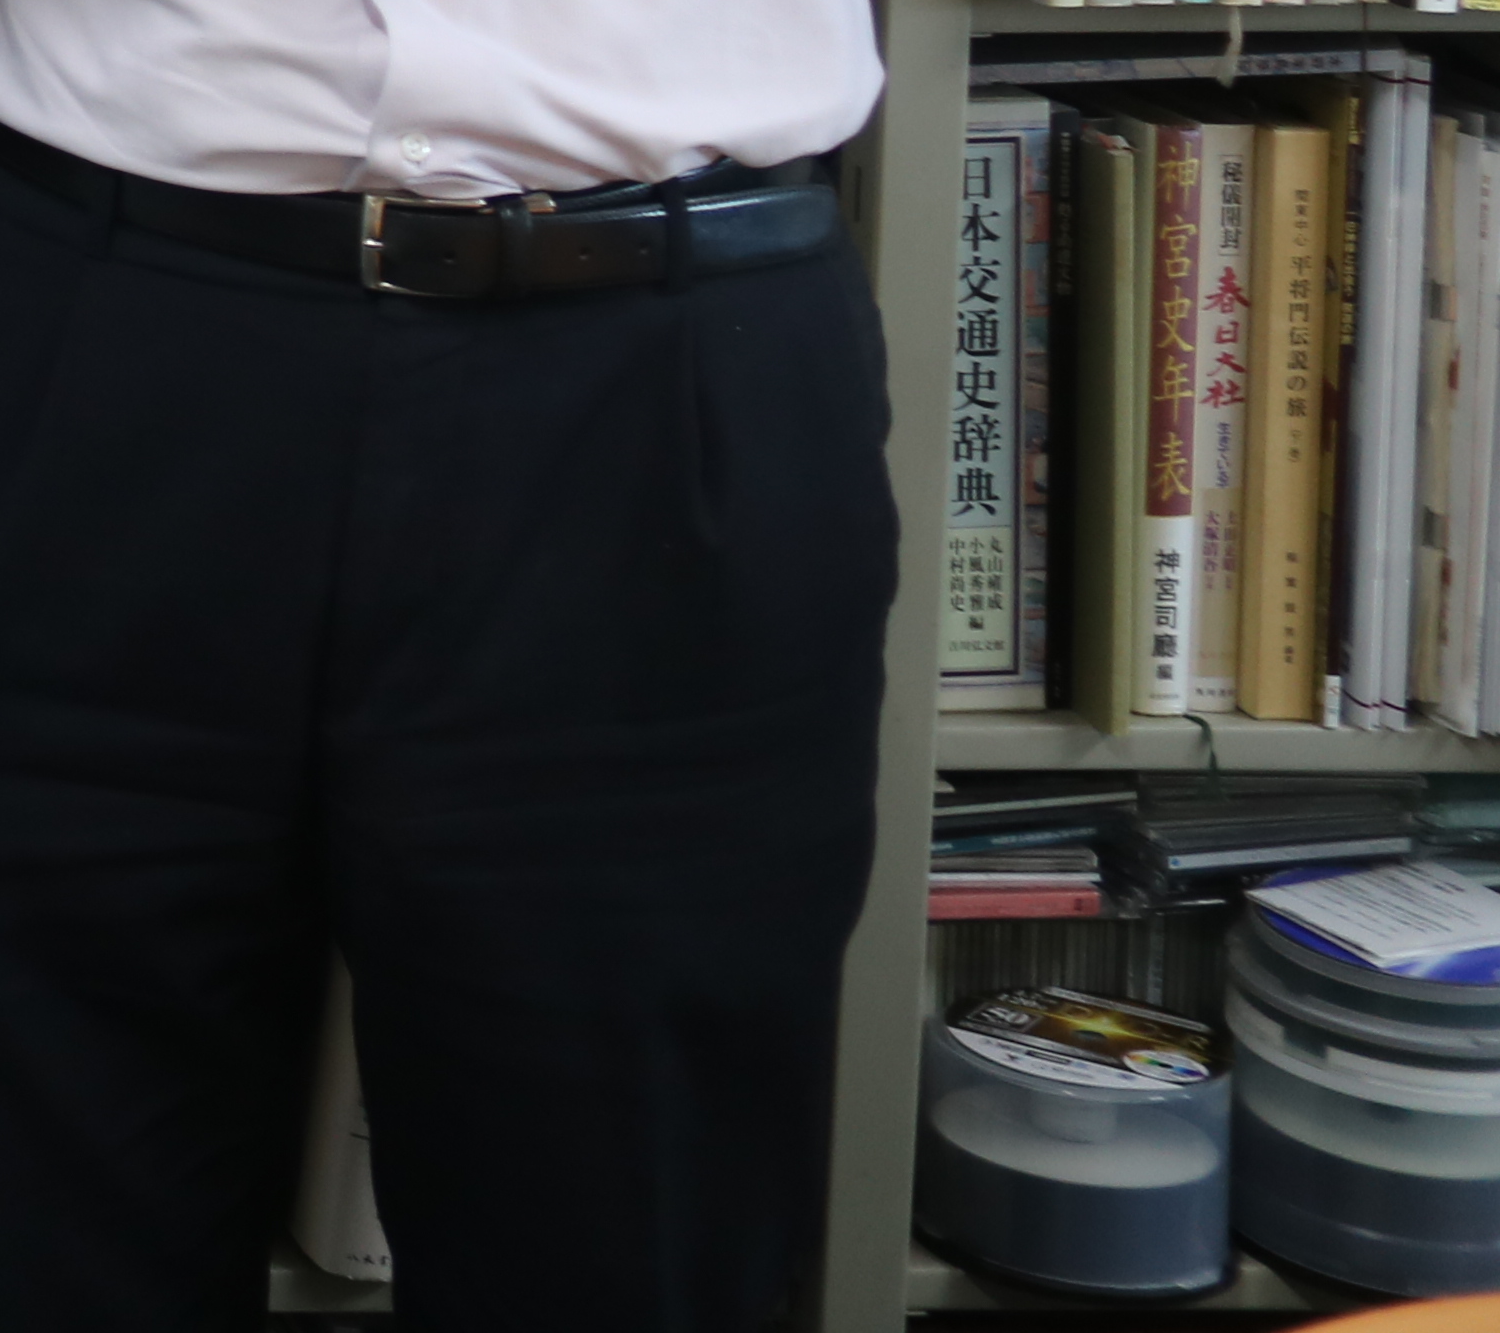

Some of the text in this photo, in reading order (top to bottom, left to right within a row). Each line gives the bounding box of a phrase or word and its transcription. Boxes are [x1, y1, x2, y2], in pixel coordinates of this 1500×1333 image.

[951, 154, 1002, 518] 日本交通史辞典
